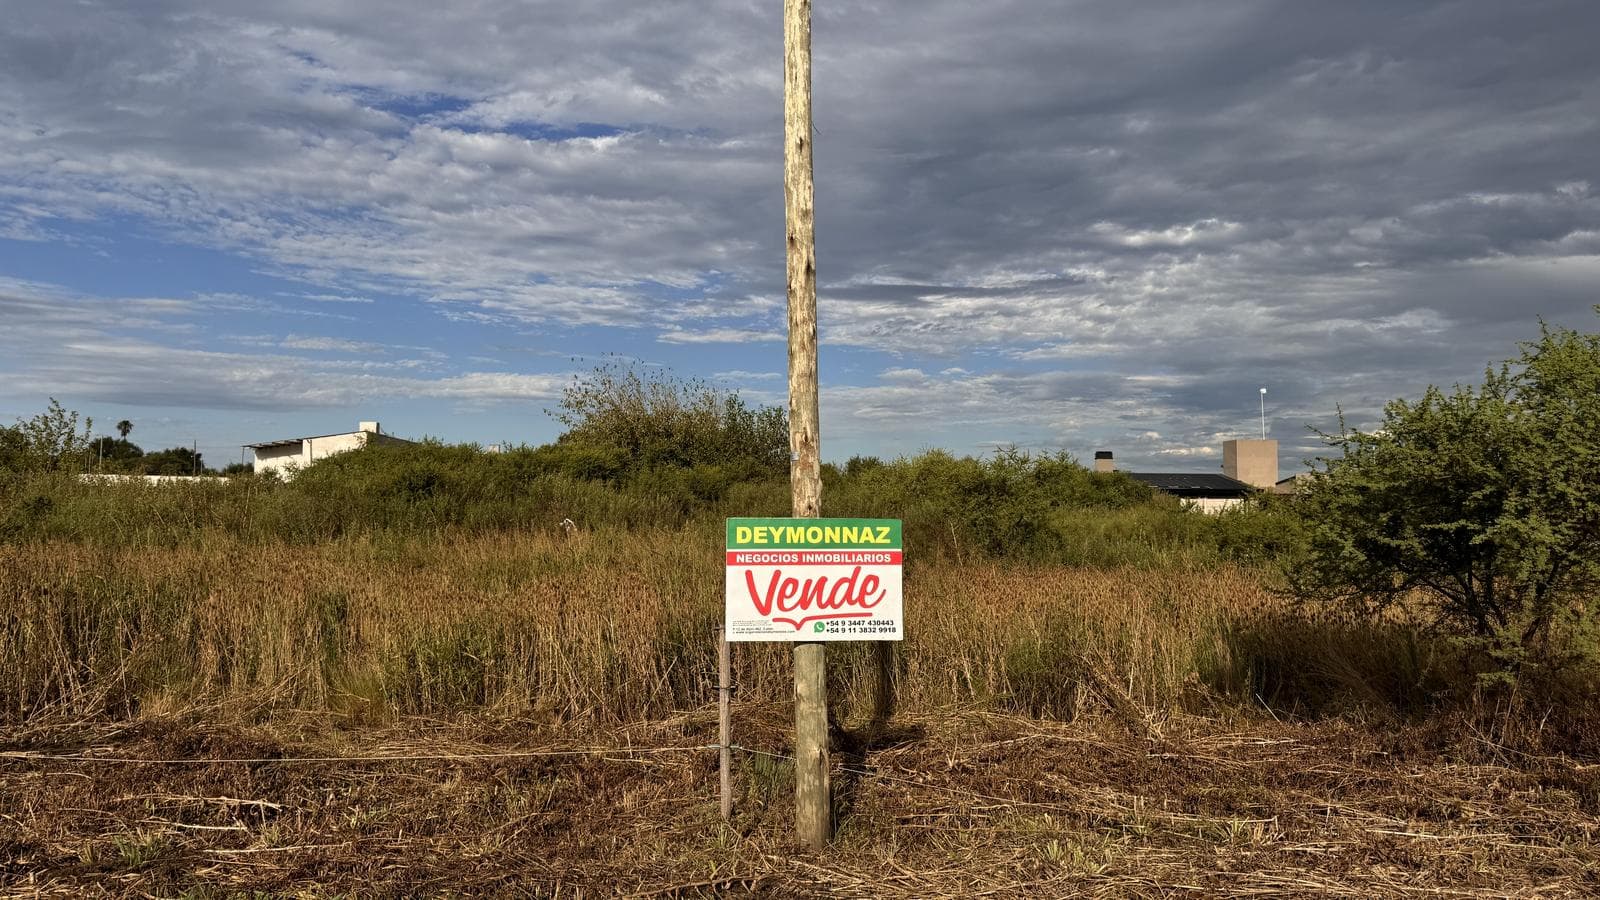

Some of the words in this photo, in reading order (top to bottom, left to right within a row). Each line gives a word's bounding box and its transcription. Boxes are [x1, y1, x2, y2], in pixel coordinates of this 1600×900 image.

[736, 526, 891, 544] DEYMONNAZ
[736, 554, 798, 563] NEGOCIOS
[802, 553, 892, 563] INMOBILIARIOS
[745, 566, 886, 616] Vende
